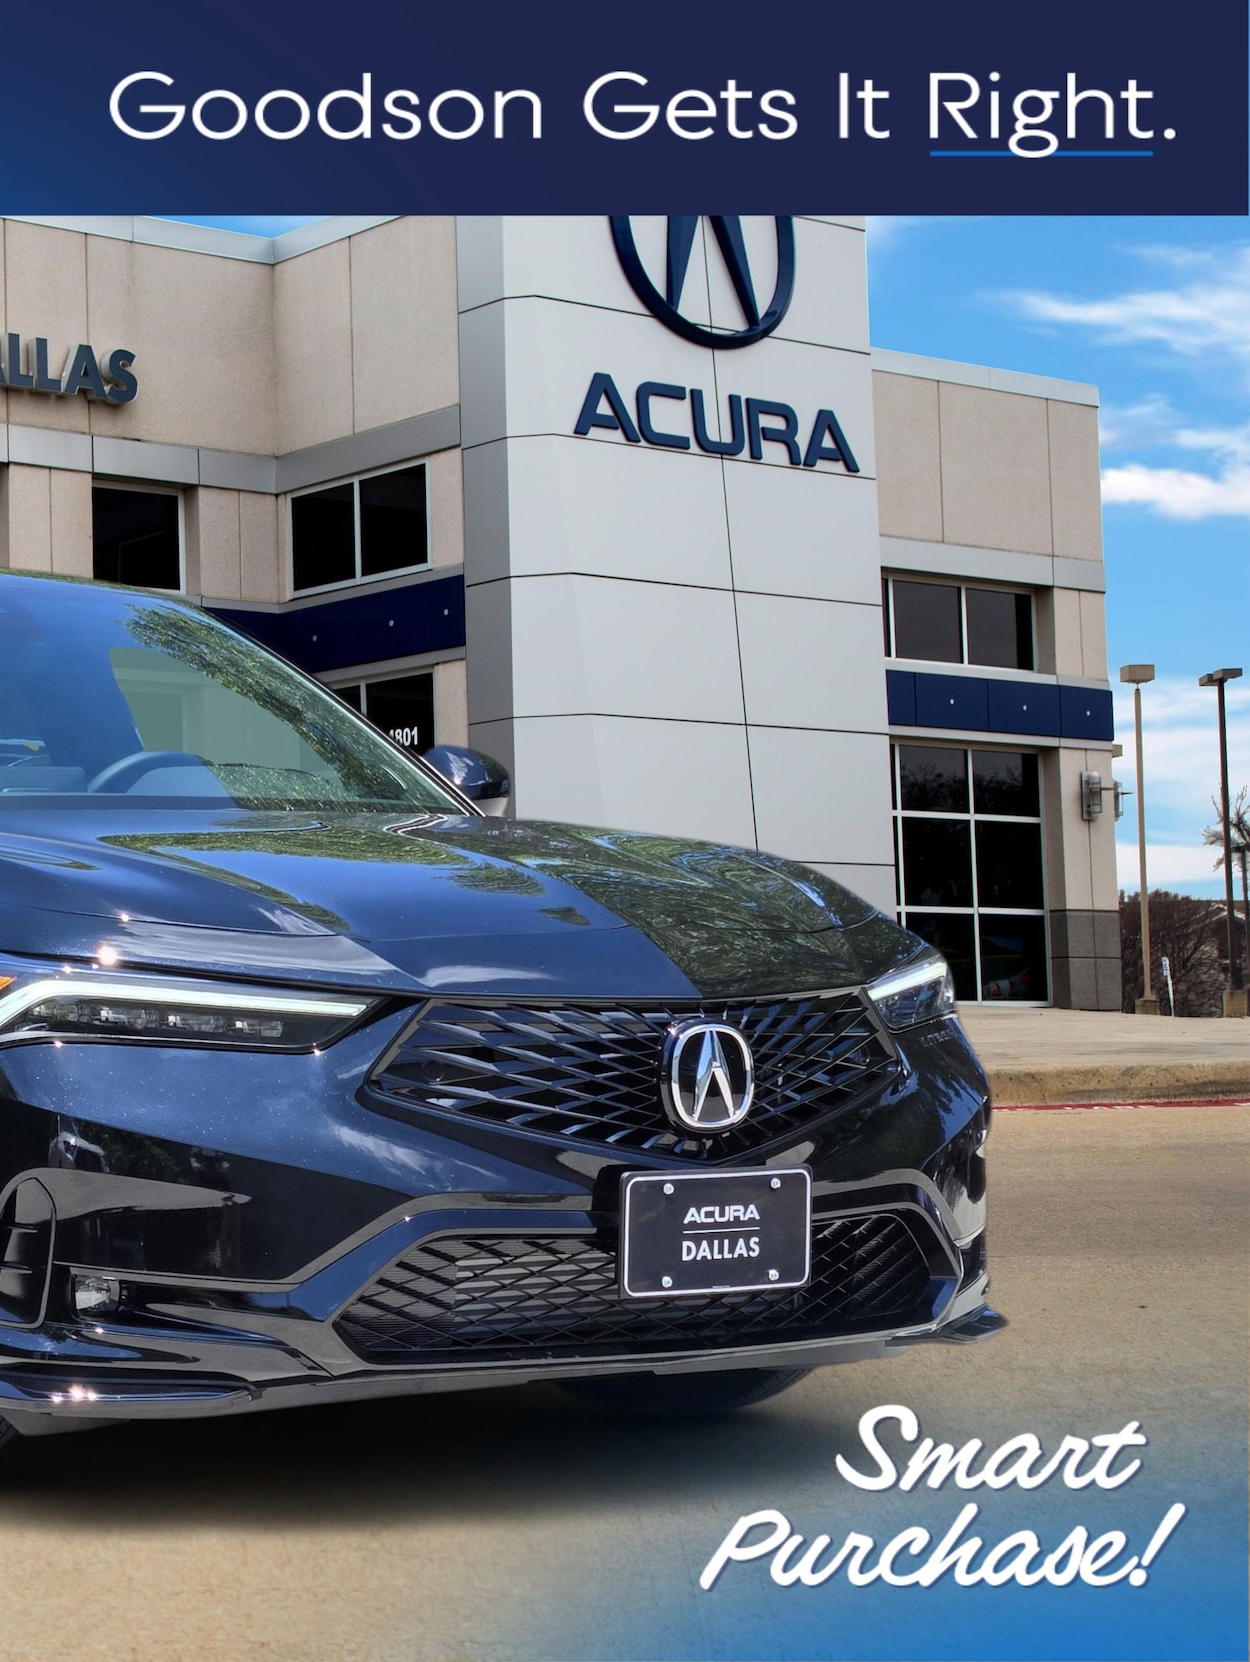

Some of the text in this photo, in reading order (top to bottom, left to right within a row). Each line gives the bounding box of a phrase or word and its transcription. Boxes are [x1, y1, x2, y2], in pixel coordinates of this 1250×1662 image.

[573, 371, 860, 474] ACURA
[683, 1203, 761, 1225] ACURA
[681, 1236, 761, 1262] DALLAS
